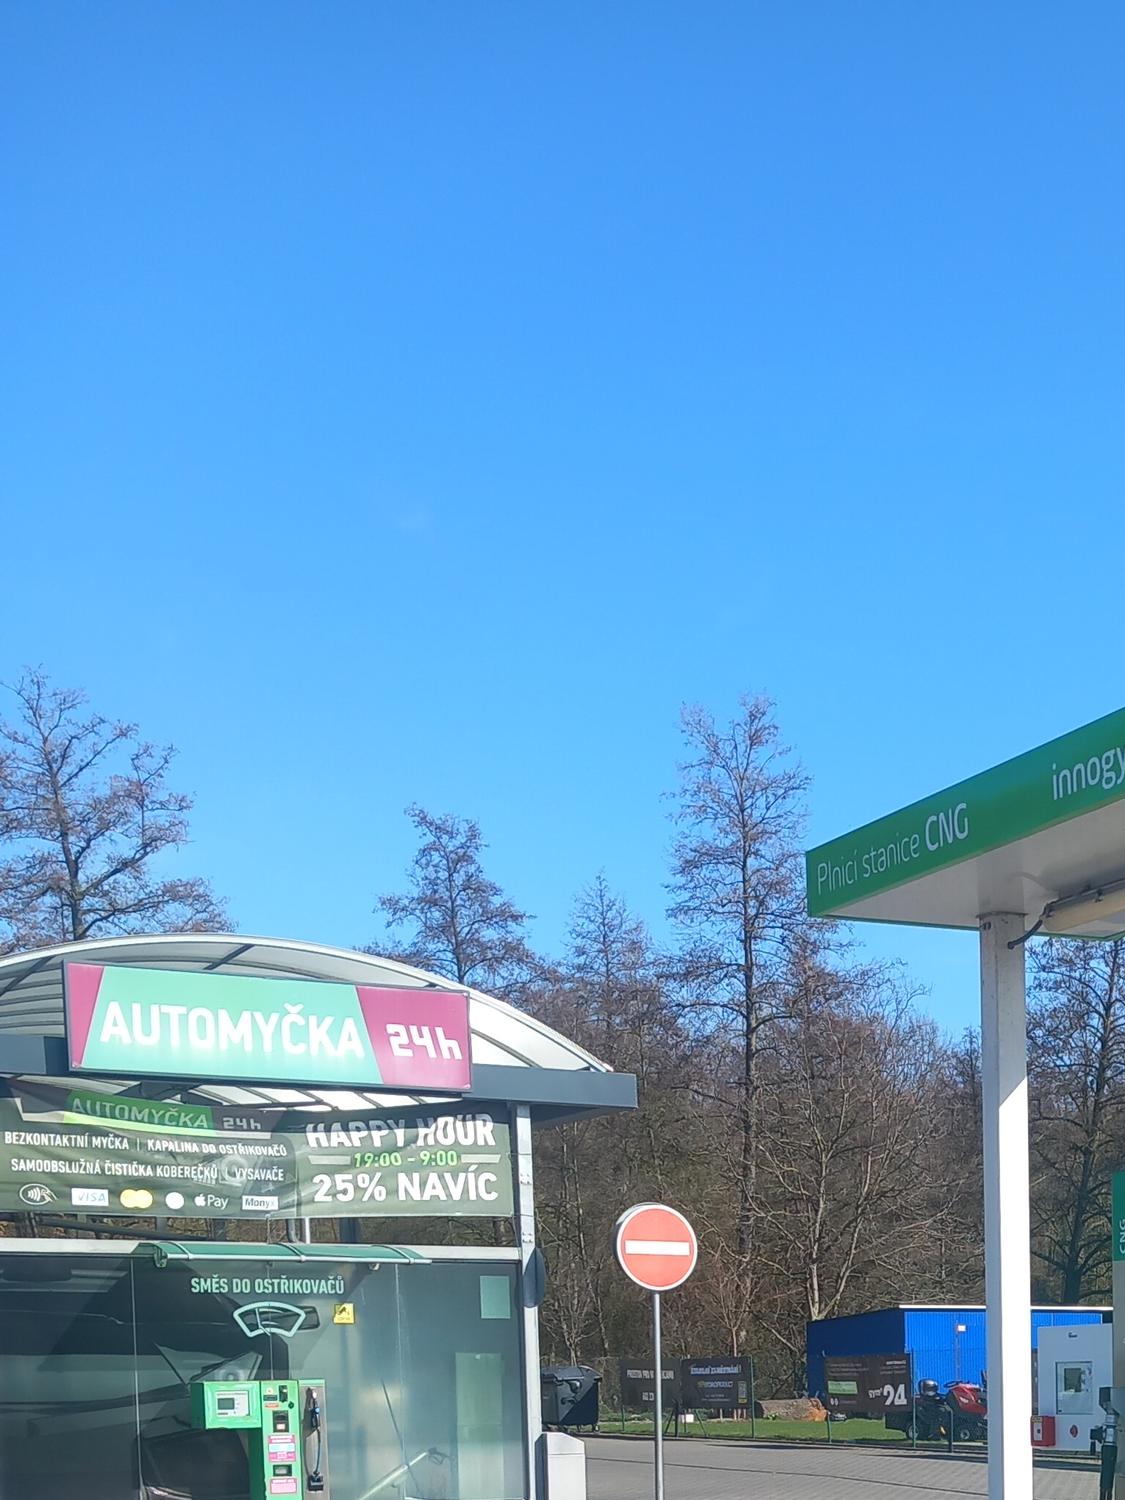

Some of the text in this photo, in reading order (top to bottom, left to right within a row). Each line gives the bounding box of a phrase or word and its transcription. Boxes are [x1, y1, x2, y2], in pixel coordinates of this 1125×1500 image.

[817, 802, 968, 895] Plnicí stanice CNG
[100, 1000, 463, 1060] AUTOMYČKA 24h
[71, 1098, 262, 1130] AUTOMYČKA 24h
[306, 1114, 496, 1148] HAPPY HOUR
[4, 1132, 288, 1157] BEZKONTAKTNÍ MYČKA KAPALINA DO OSTŘIKOVAČŮ
[11, 1157, 285, 1181] SAMOOBSLUŽNÁ ČISTIČKA KOBEREČKŮ VYSAVAČE
[354, 1151, 402, 1168] 19:00
[420, 1150, 458, 1166] 9:00
[312, 1164, 499, 1202] 25% NAVÍC
[78, 1192, 106, 1203] VISA
[208, 1194, 229, 1210] Pay
[191, 1274, 345, 1295] SMĚS DO OSTŘIKOVAČŮ
